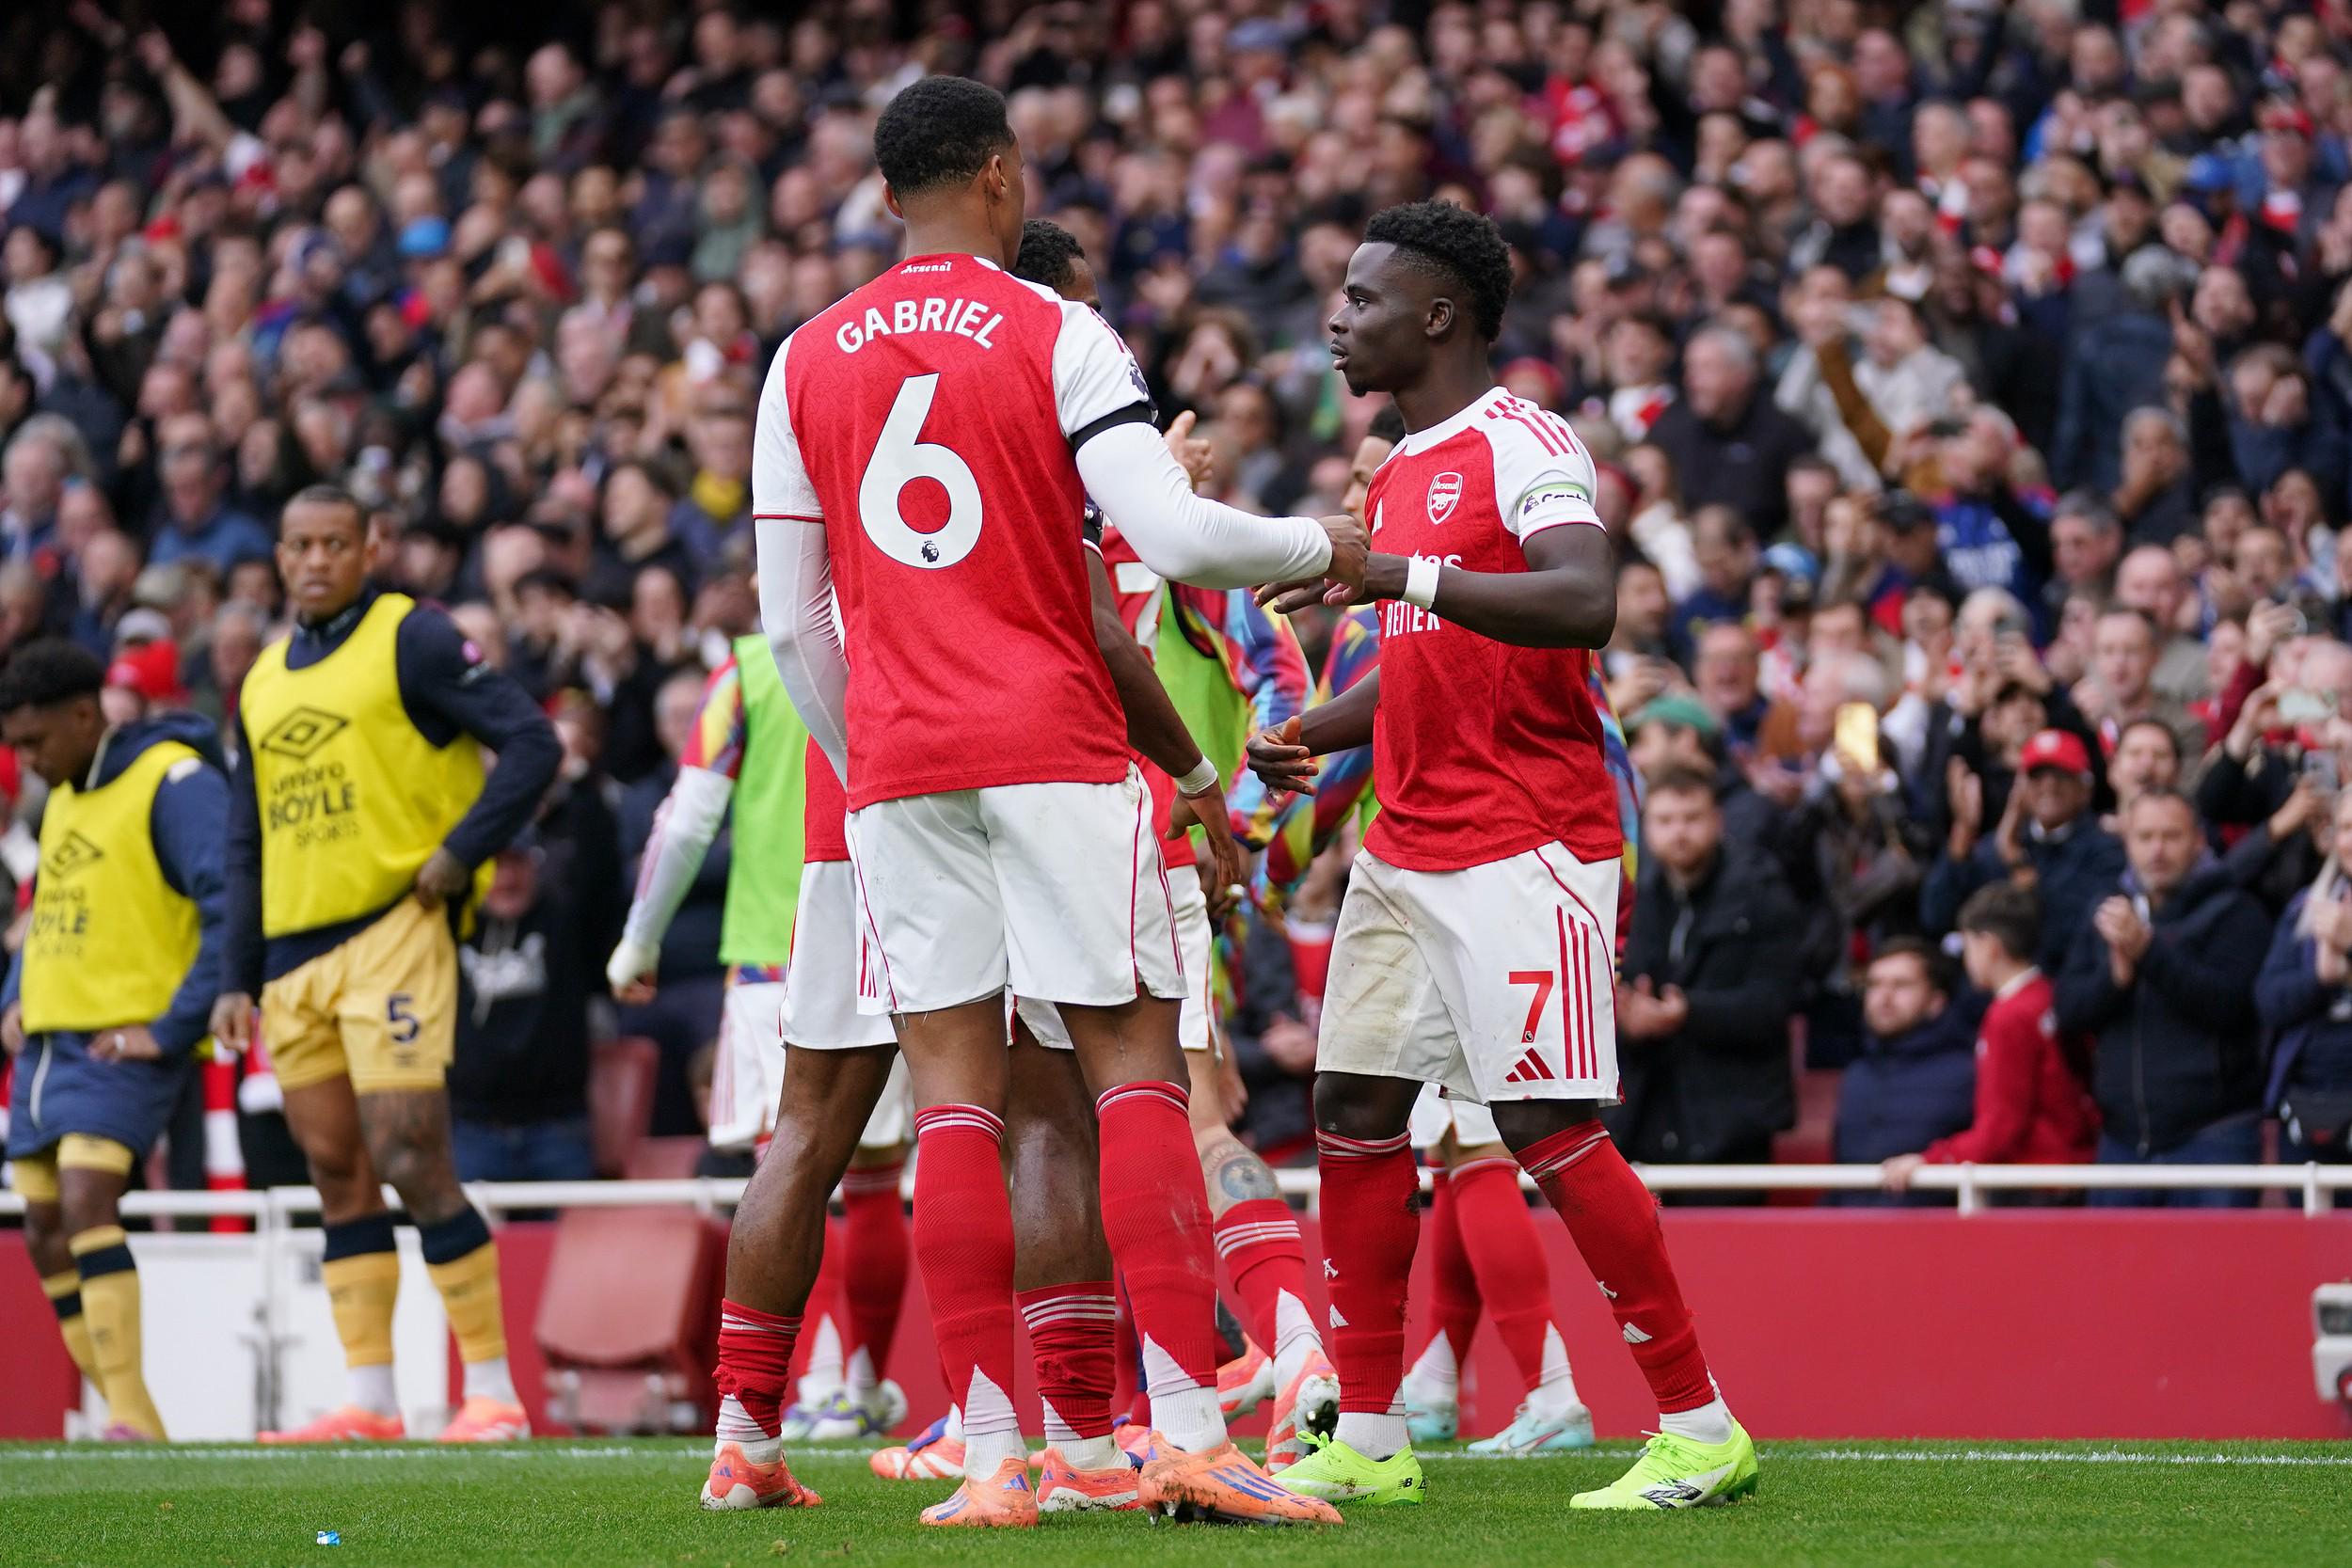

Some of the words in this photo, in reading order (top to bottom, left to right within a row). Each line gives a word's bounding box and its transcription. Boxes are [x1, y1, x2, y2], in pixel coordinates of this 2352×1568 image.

[900, 261, 952, 275] Arsenal
[835, 297, 1004, 355] GABRIEL
[857, 372, 983, 570] 6
[1434, 481, 1459, 490] Arsenal
[268, 782, 356, 832] BOYLE
[387, 993, 420, 1044] 5
[1508, 970, 1554, 1044] 7
